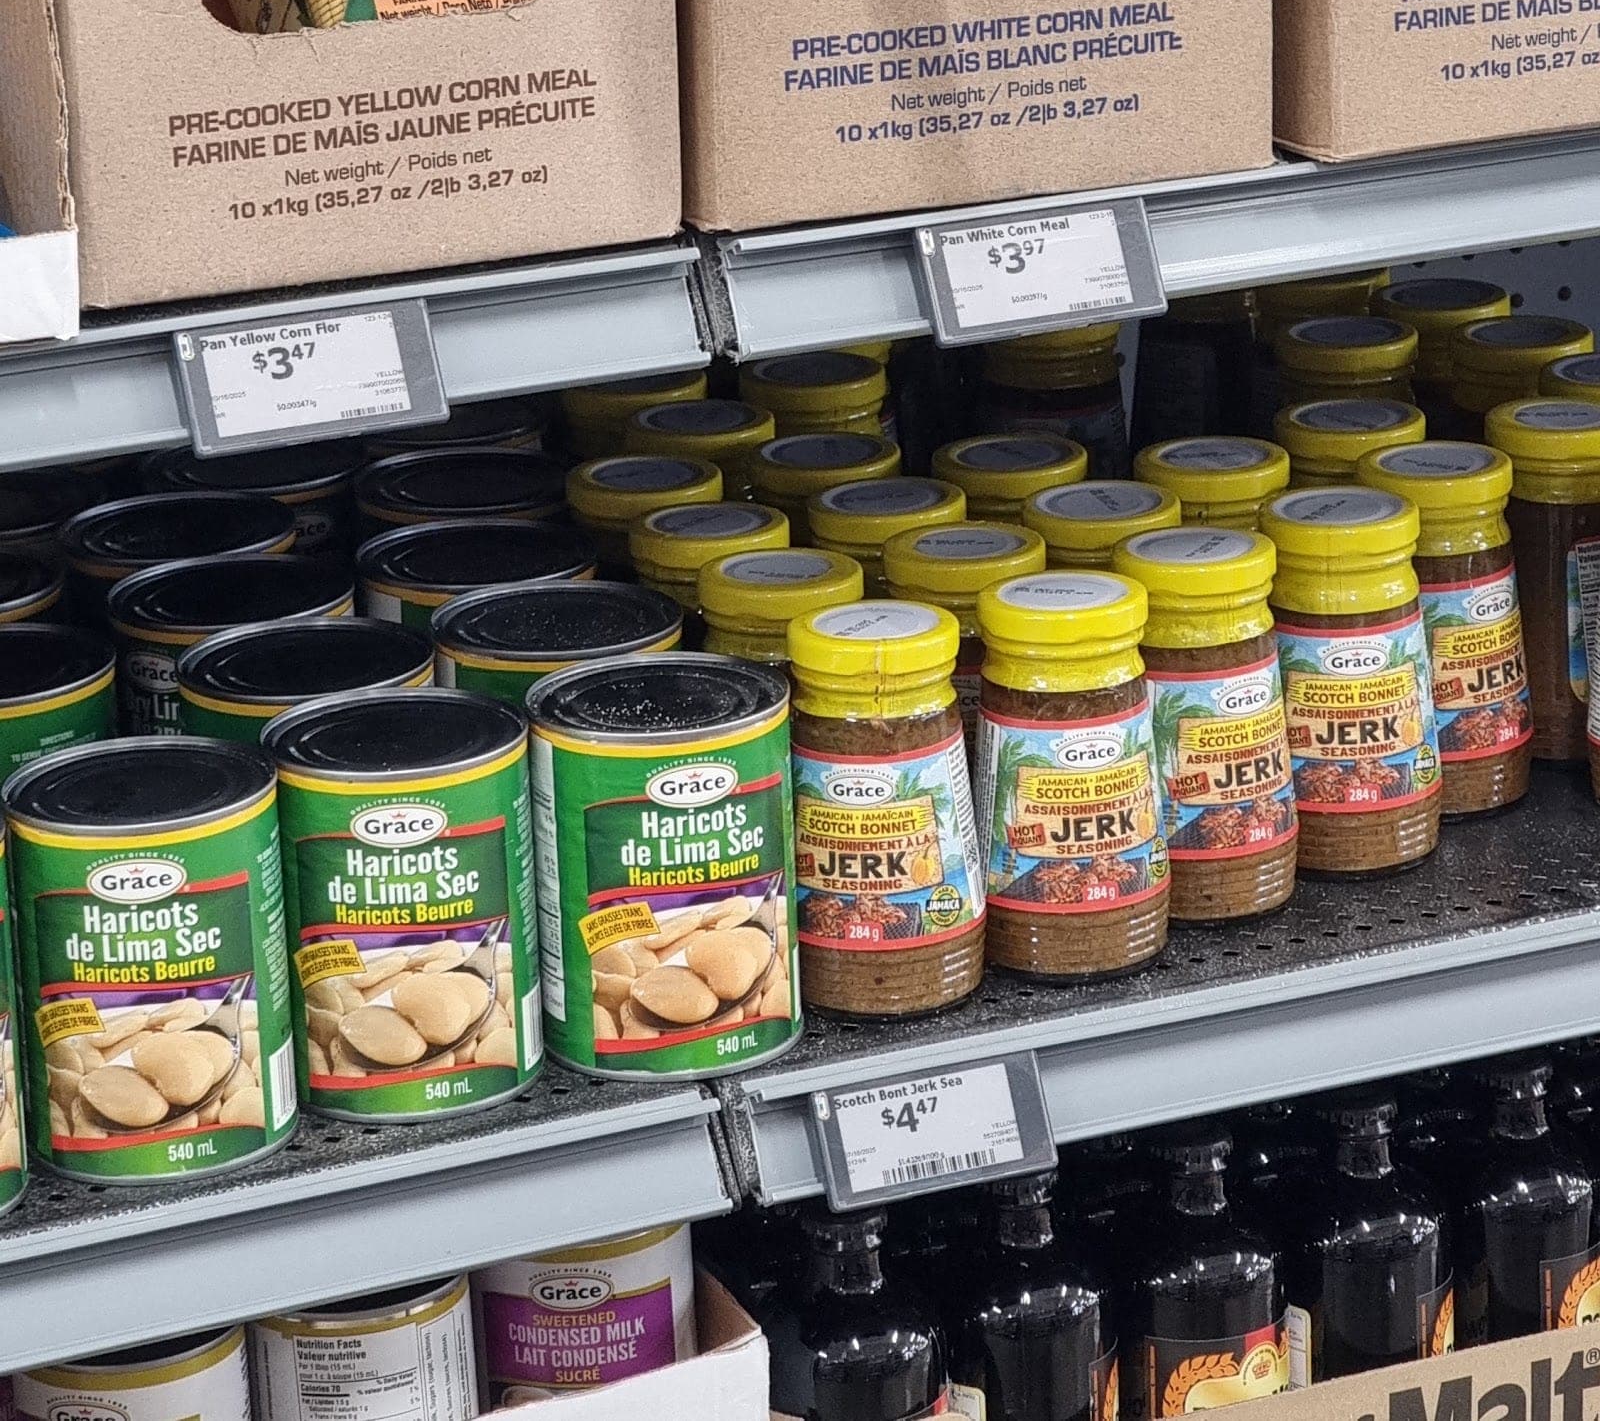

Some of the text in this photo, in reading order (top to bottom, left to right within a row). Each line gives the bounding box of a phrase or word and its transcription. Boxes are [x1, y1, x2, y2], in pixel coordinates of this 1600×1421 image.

[792, 1, 1174, 61] PRE-COOKED WHITE CORN MEAL
[1394, 5, 1476, 33] FARINE
[1482, 1, 1511, 23] DE
[1491, 26, 1578, 52] Net weight
[784, 29, 1182, 92] FARINE DE MAÏS BLANC PRÉCUITE
[169, 68, 597, 138] PRE-COOKED YELLOW CORN MEAL
[891, 92, 924, 112] Net
[927, 86, 986, 109] weight
[1007, 78, 1055, 98] Poids
[1059, 75, 1087, 92] net
[172, 95, 596, 168] FARINE DE MAÏS JAUNE PRÉCUITE
[940, 218, 1070, 247] Pan White Corn Meal
[200, 322, 341, 353] Pan Yellow Corn Flor
[1453, 631, 1494, 644] JAMAICAN
[1303, 685, 1406, 704] SCOTCH BONNET
[1315, 714, 1401, 746] JERK
[1065, 747, 1117, 762] Grace
[1186, 741, 1280, 764] ASSAISONNEMENT
[1320, 741, 1396, 757] SEASONING
[1173, 783, 1208, 797] PIQUANT
[641, 802, 748, 839] Haricots
[808, 819, 917, 834] SCOTCH BONNET
[1013, 825, 1036, 837] HOT
[1050, 810, 1136, 843] JERK
[621, 824, 765, 869] de Lima Sec
[1011, 835, 1043, 846] PIQUANT
[346, 846, 459, 877] Haricots
[629, 855, 760, 888] Haricots Beurre
[818, 850, 909, 880] JERK
[328, 869, 480, 905] de Lima Sec
[822, 878, 903, 891] SEASONING
[1087, 887, 1115, 902] 284 g
[82, 900, 200, 934] Haricots
[335, 896, 475, 925] Haricots Beurre
[926, 899, 961, 913] JAMAICA
[65, 924, 222, 962] de Lima Sec
[73, 953, 215, 984] Haricots Beurre
[425, 1077, 472, 1100] 540 mL
[834, 1074, 963, 1111] Scotch Bont Jerk Sea
[167, 1138, 218, 1161] 540 mL
[508, 1316, 646, 1347] CONDENSED MILK
[532, 1310, 616, 1328] SWEETENED
[296, 1339, 362, 1350] Nutrition Facts
[297, 1349, 367, 1362] Valeur nutritive
[514, 1337, 638, 1368] LAIT CONDENSÉ
[300, 1383, 329, 1393] Calories
[555, 1366, 601, 1383] SUCRÉ
